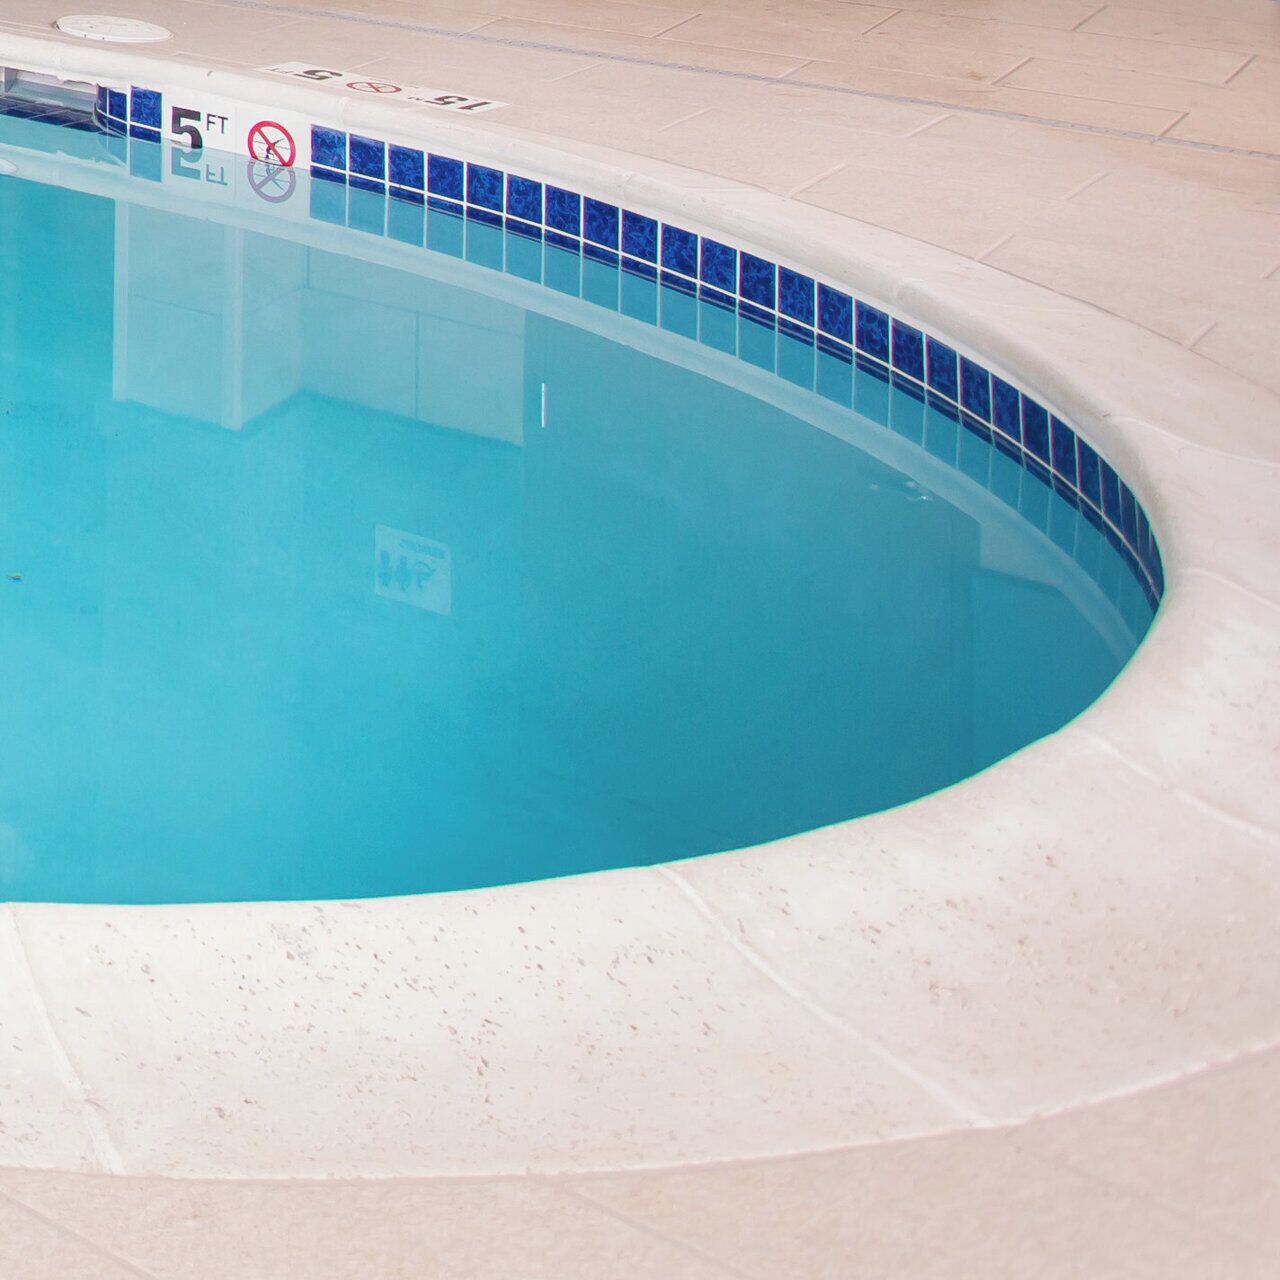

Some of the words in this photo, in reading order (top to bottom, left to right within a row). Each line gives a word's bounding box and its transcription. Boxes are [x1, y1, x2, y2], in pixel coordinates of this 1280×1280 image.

[293, 69, 343, 81] 5
[171, 105, 203, 149] 5
[206, 113, 229, 135] FT
